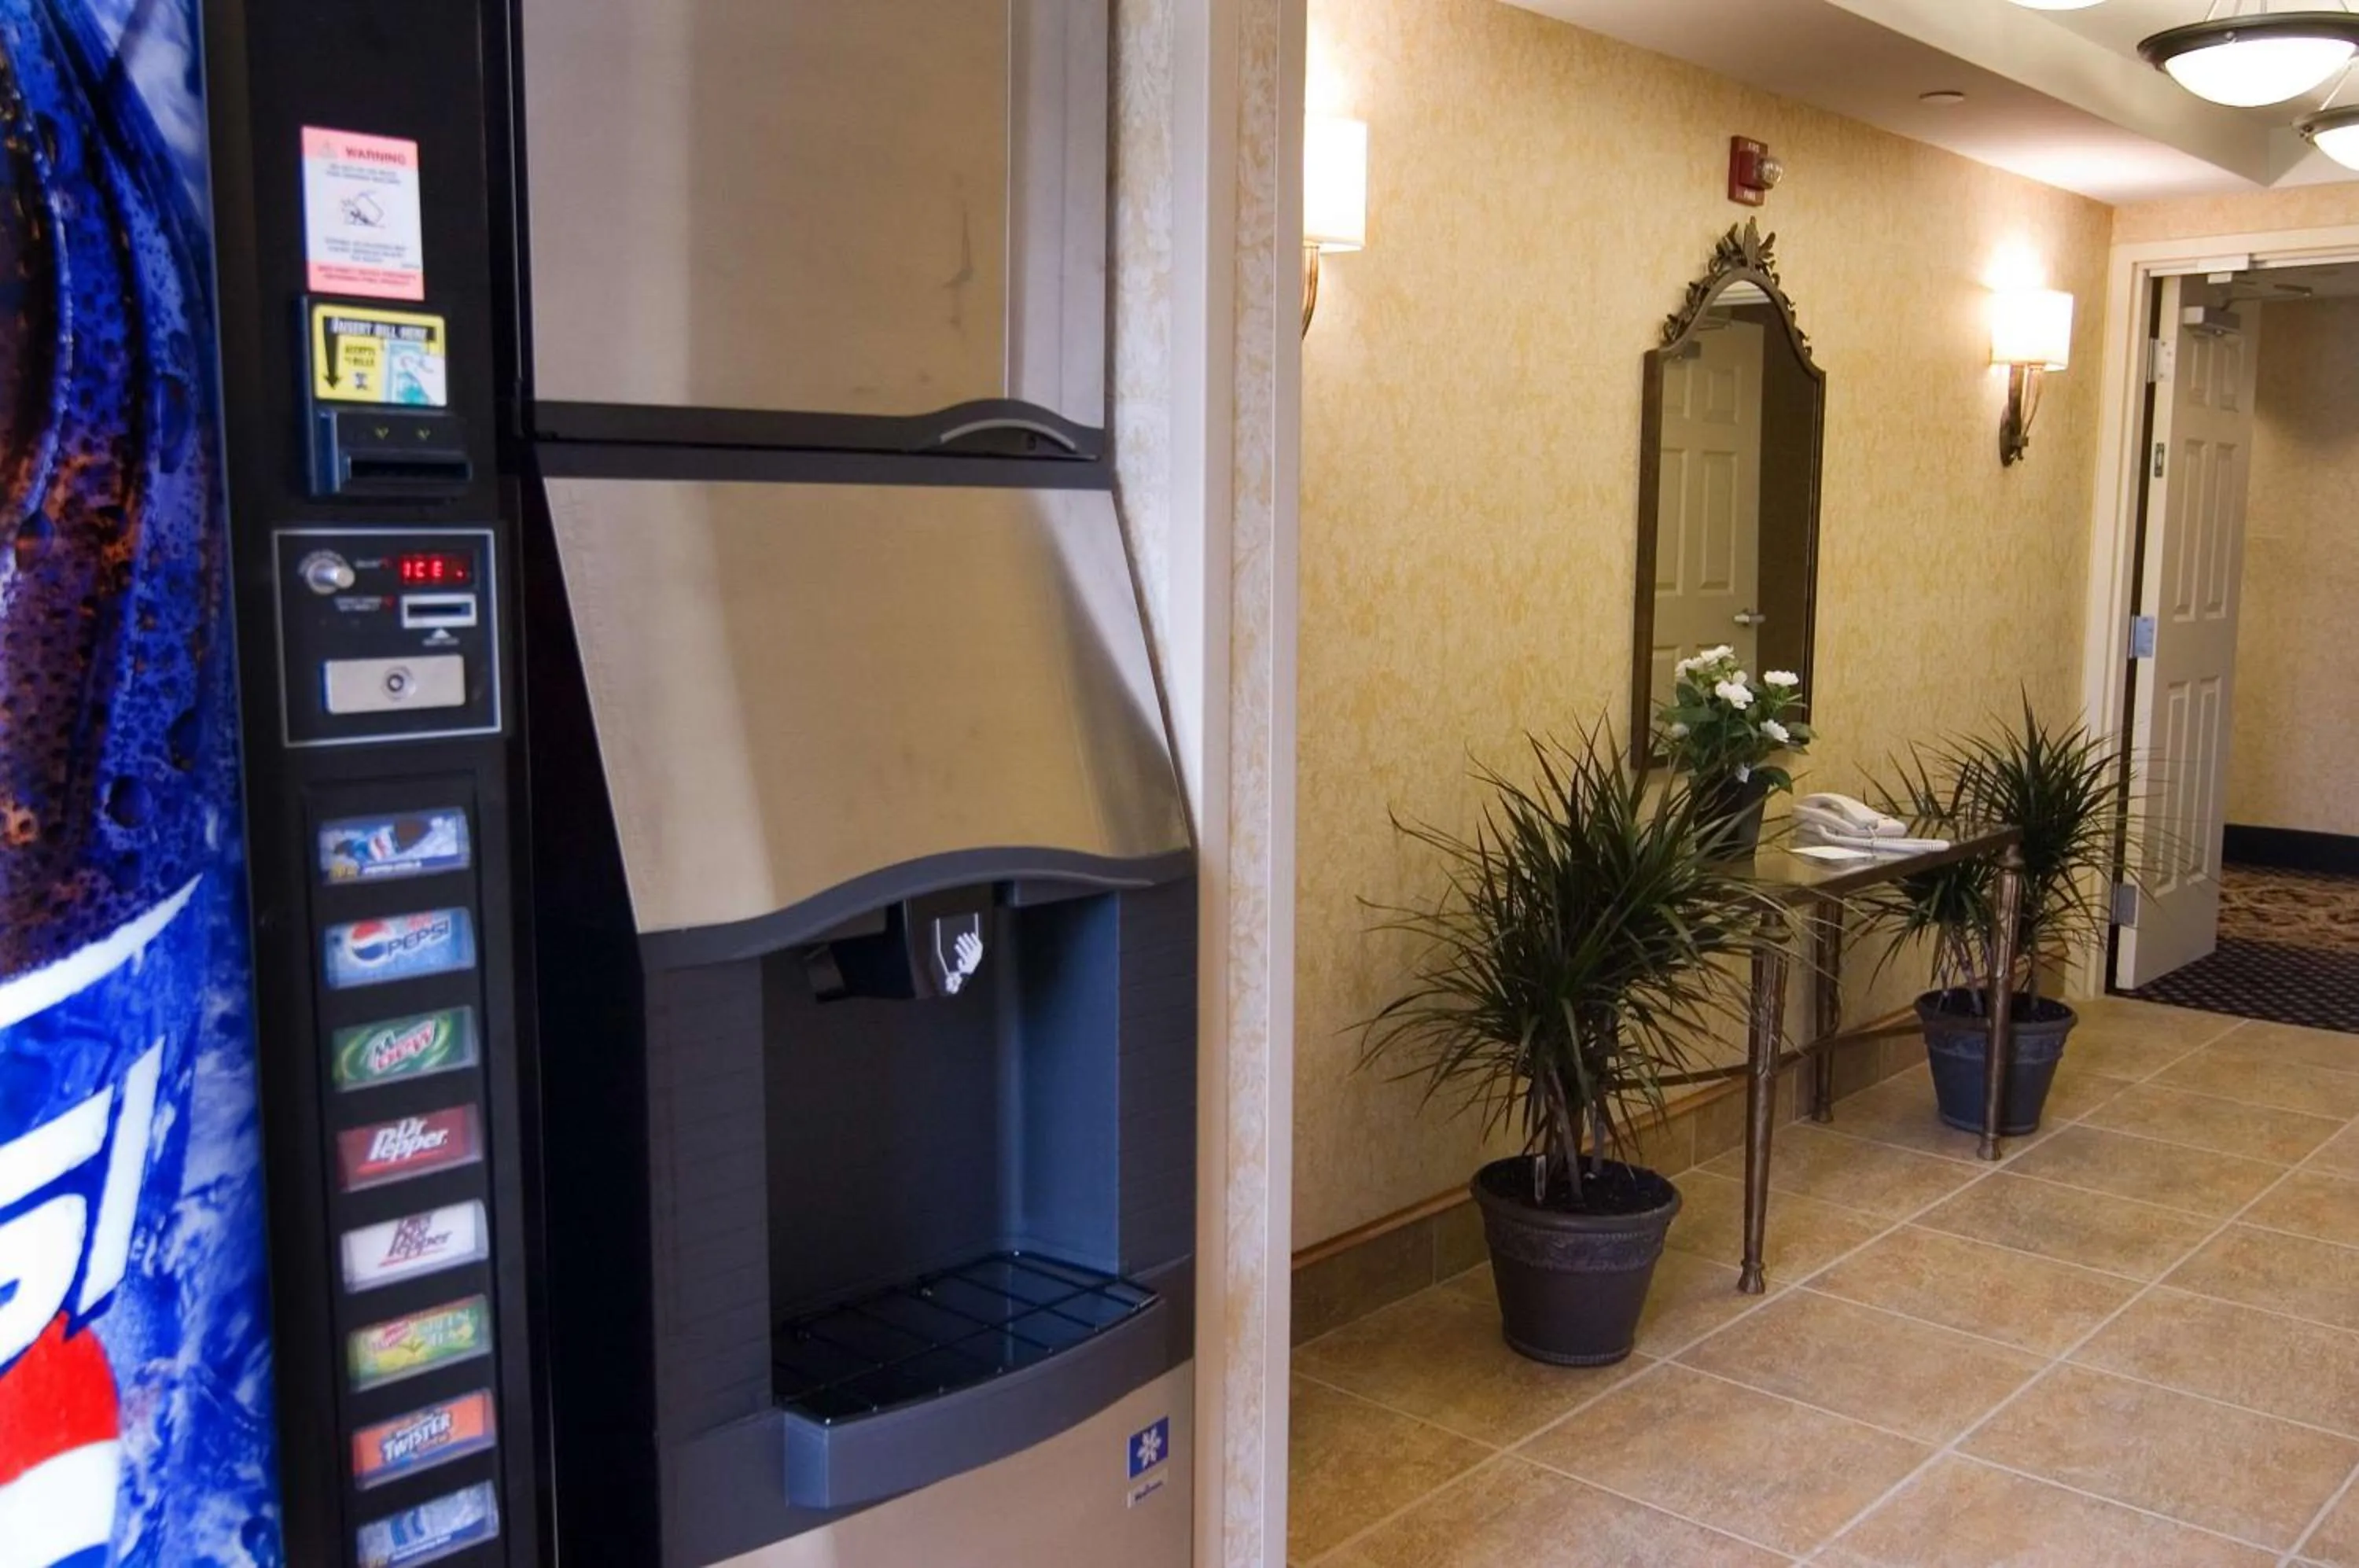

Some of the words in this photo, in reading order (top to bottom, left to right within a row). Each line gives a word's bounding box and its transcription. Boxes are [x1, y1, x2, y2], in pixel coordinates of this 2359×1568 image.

[345, 146, 407, 165] WARNING
[388, 918, 449, 957] PEPSI
[368, 1128, 449, 1162] Pepper
[384, 1412, 451, 1461] TWISTER
